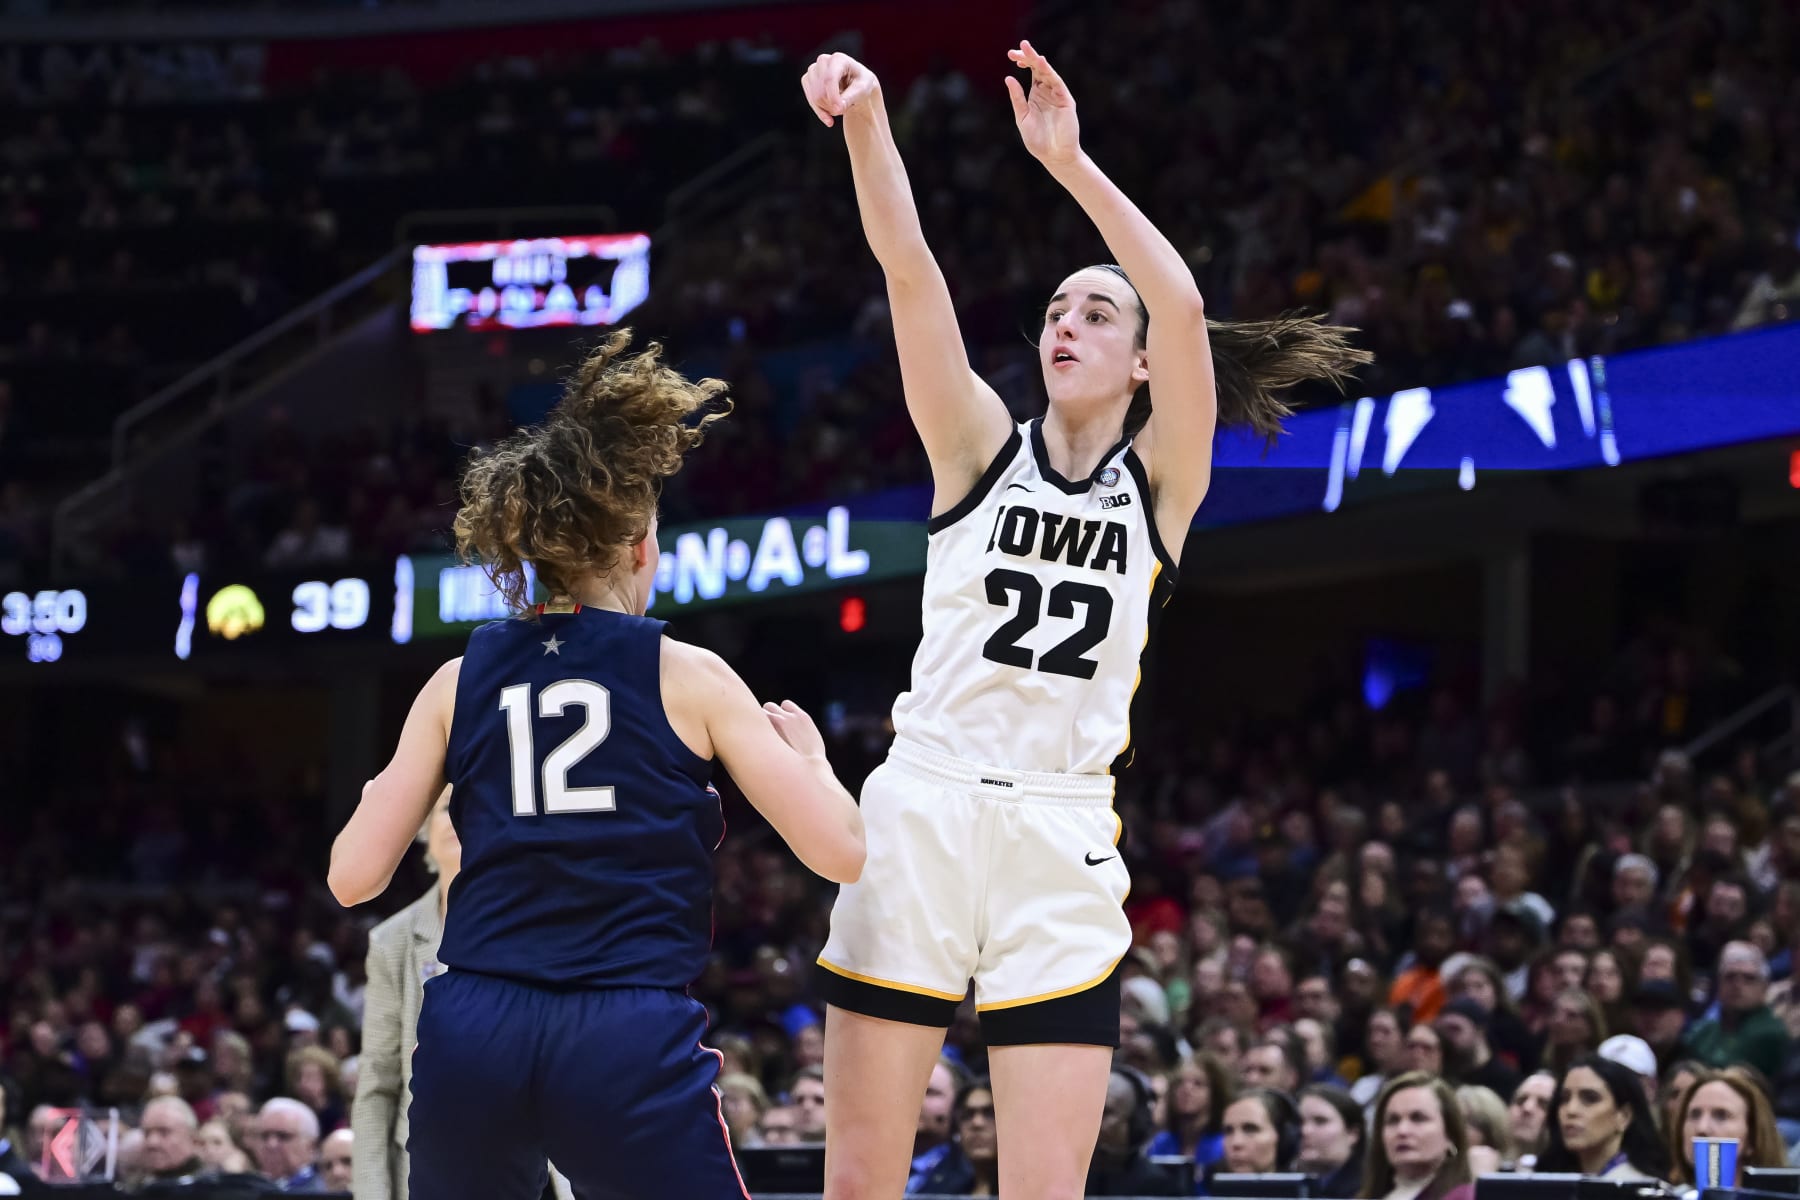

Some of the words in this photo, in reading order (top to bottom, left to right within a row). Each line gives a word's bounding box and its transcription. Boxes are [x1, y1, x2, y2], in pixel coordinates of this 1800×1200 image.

[986, 505, 1128, 575] IOWA
[291, 578, 370, 632] 39
[982, 568, 1114, 680] 22
[499, 678, 617, 816] 12
